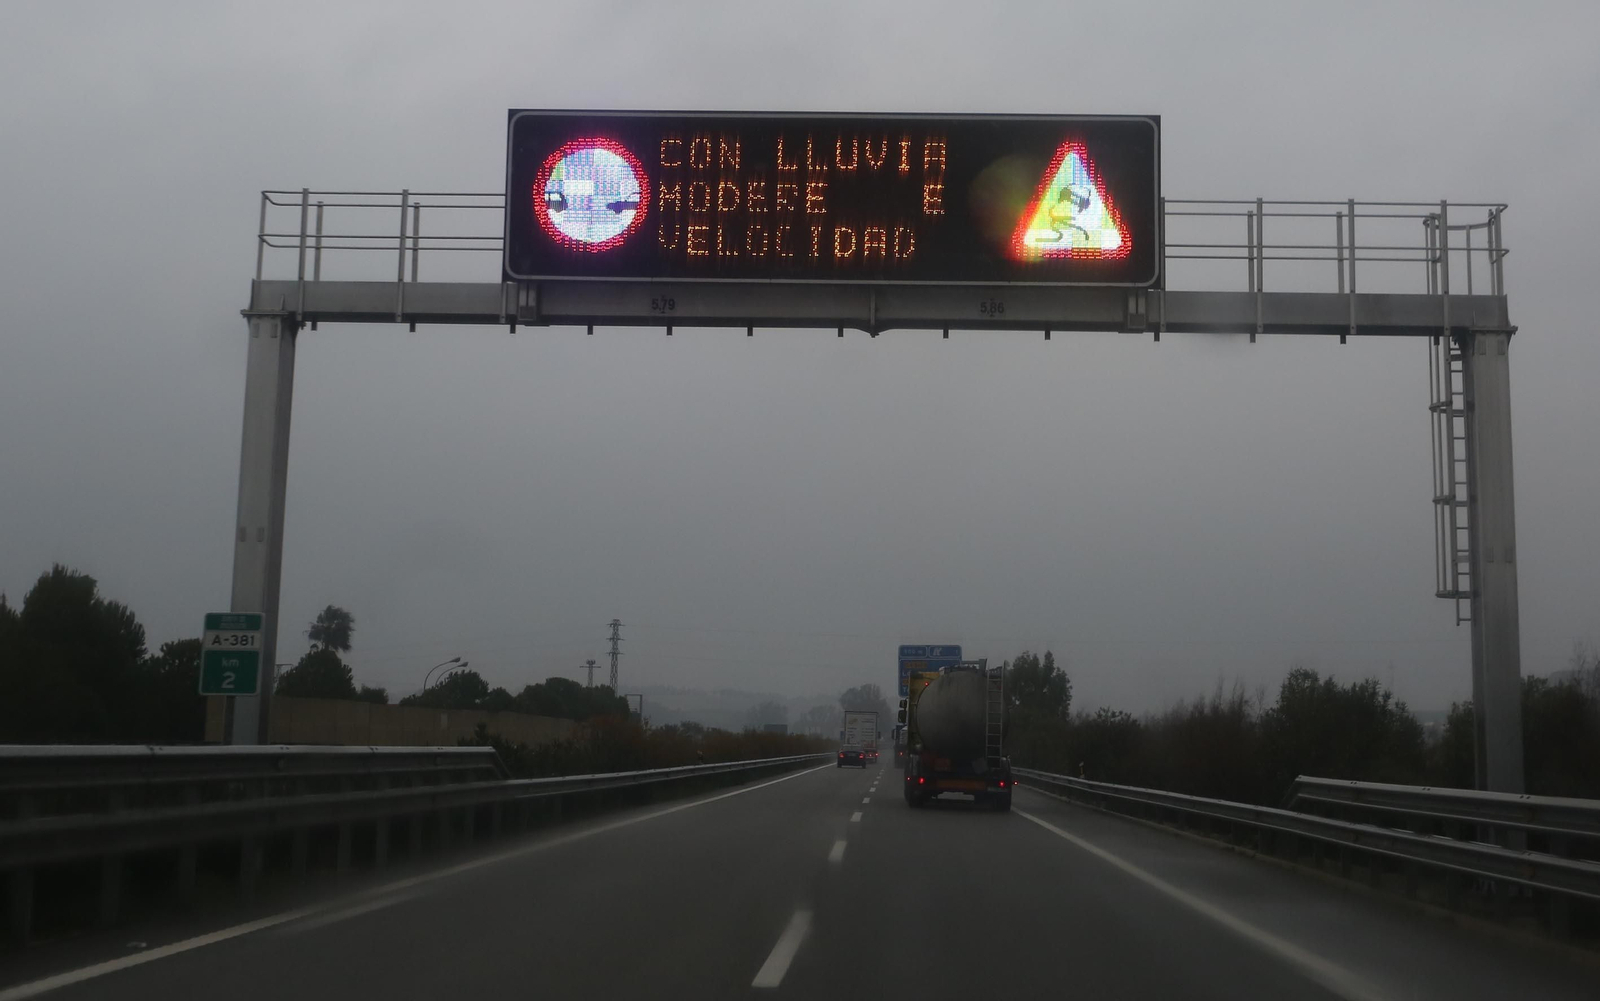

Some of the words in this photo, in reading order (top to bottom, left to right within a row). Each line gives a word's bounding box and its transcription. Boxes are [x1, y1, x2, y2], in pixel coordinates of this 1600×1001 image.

[660, 138, 741, 170] CON
[776, 138, 947, 171] LLUVIA
[659, 181, 829, 213] MODERE
[922, 183, 946, 215] E
[658, 224, 916, 257] VELOCIDAD
[211, 634, 255, 647] A-381
[221, 657, 240, 668] km
[221, 671, 236, 689] 2
